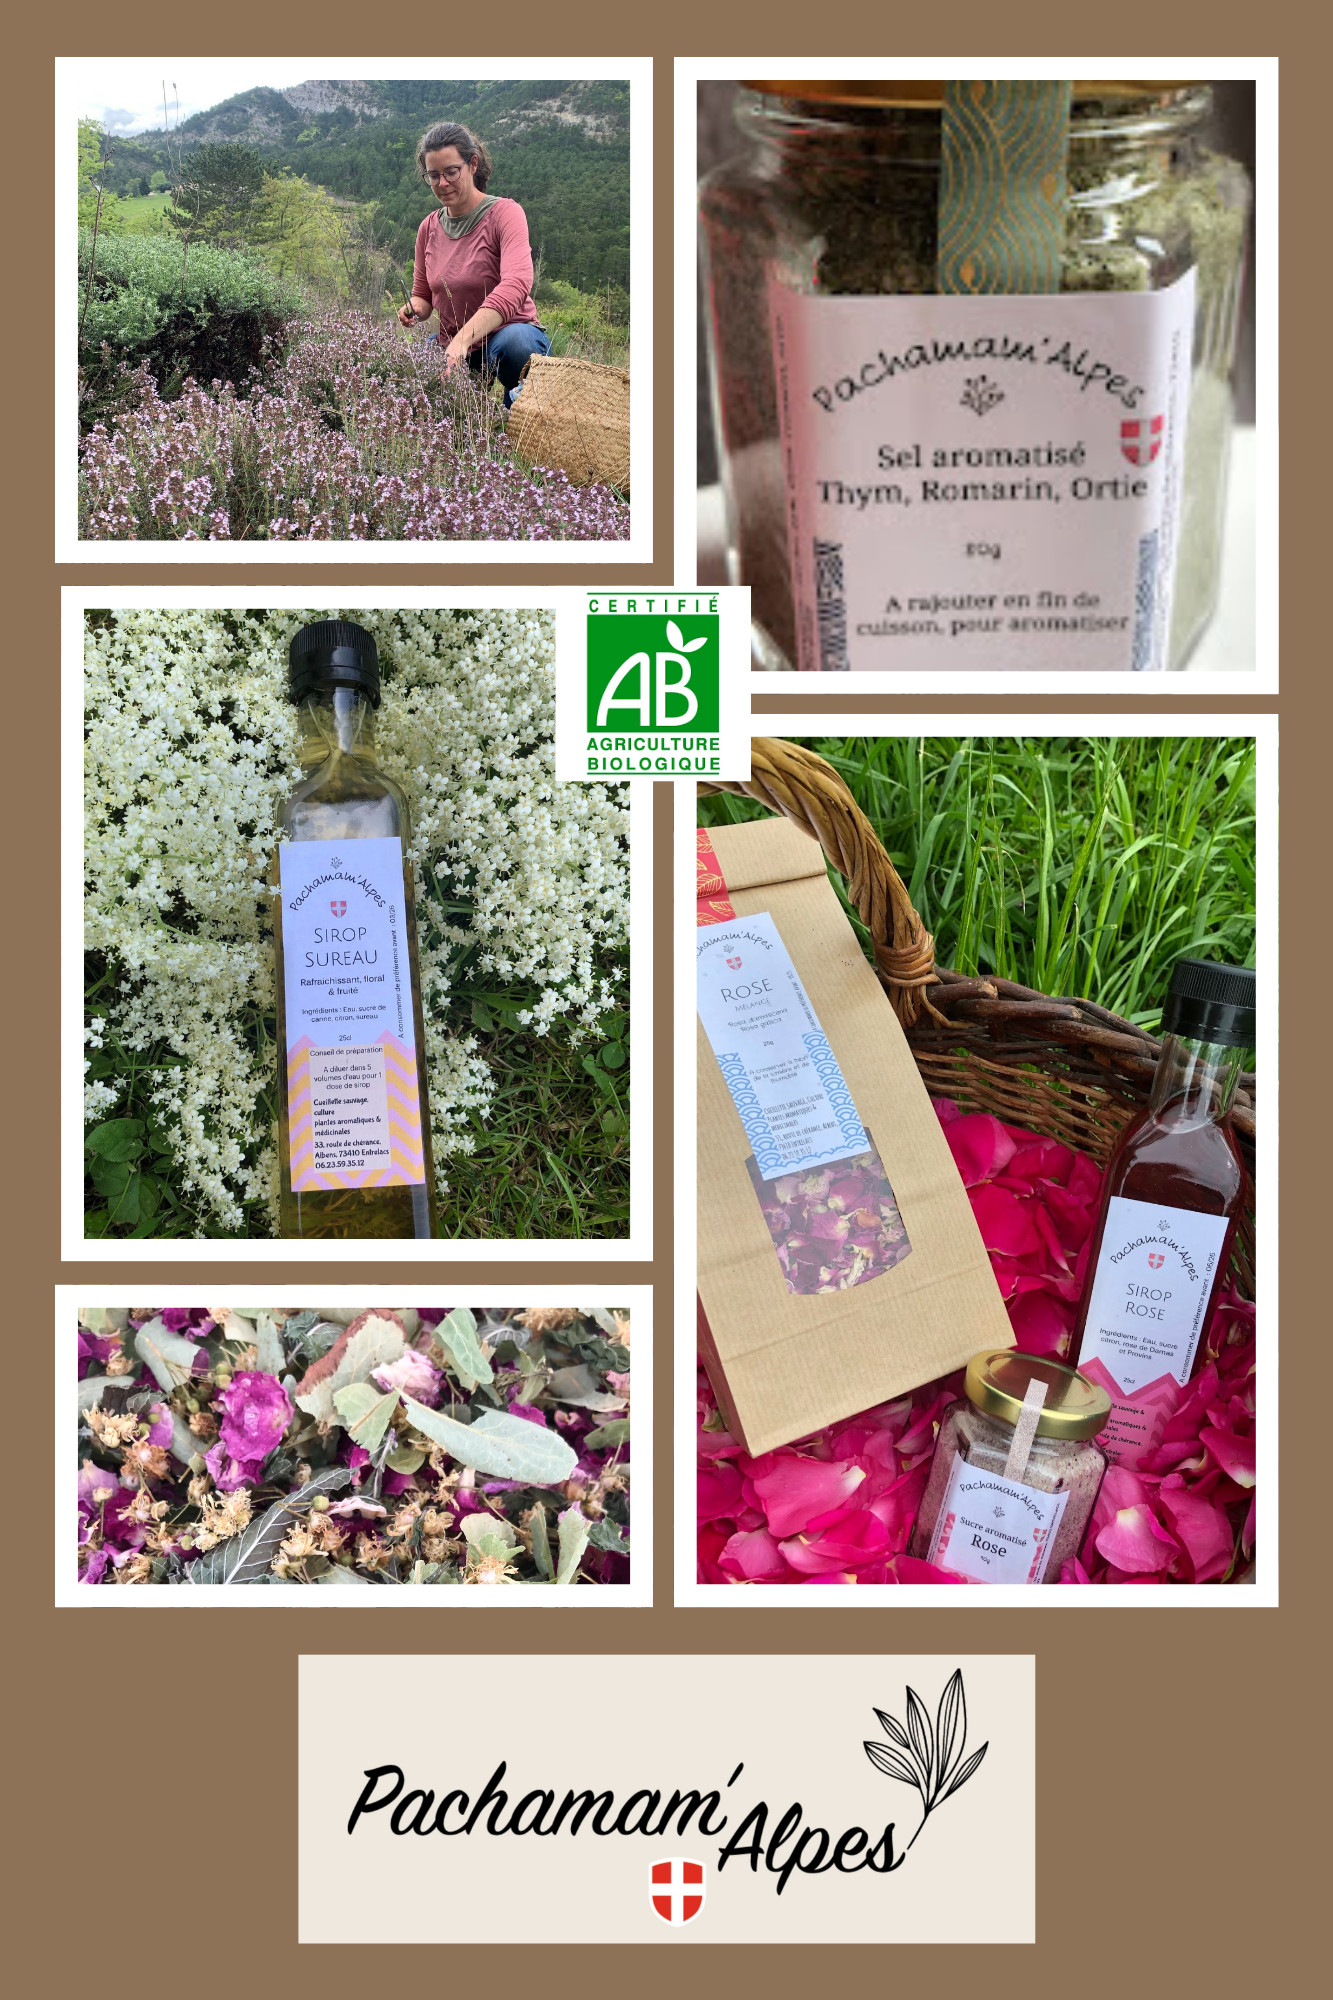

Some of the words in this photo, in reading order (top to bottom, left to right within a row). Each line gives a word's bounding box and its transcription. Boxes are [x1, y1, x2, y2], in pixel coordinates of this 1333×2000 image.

[812, 335, 1147, 414] Pachamam'Alpes
[878, 444, 921, 469] Sel
[932, 442, 1086, 468] aromatisé
[817, 479, 912, 510] Thym,
[921, 478, 1061, 504] Romarin,
[1071, 475, 1148, 499] Ortie
[886, 596, 901, 613] A
[908, 593, 997, 613] rajouter
[1003, 594, 1030, 609] en
[1036, 590, 1067, 608] fin
[1073, 591, 1100, 608] de
[856, 619, 944, 636] cuisson,
[951, 616, 1002, 636] pour
[1008, 614, 1129, 633] aromatiser
[290, 872, 386, 911] Pachamam'Alpes
[314, 927, 366, 943] SIROP
[305, 950, 377, 968] SUREAU
[364, 974, 385, 983] floral
[337, 987, 358, 995] fruité
[721, 979, 773, 1002] ROSE
[302, 1007, 338, 1016] Ingrédients
[735, 998, 770, 1011] MÉLANGE
[346, 1047, 383, 1055] préparation
[314, 1119, 336, 1128] plantes
[337, 1117, 374, 1125] aromatiques
[315, 1128, 350, 1136] médicinales
[339, 1149, 360, 1157] 73410
[361, 1148, 389, 1156] Entrelacs
[315, 1160, 365, 1169] 06.23.59.35.12
[1110, 1236, 1199, 1281] Pachamam'Alpes
[1126, 1283, 1172, 1302] SIROP
[1125, 1301, 1165, 1320] ROSE
[1181, 1341, 1194, 1378] consommer
[1190, 1332, 1196, 1341] de
[1193, 1295, 1205, 1331] préférence
[1201, 1278, 1209, 1296] avant
[1205, 1252, 1216, 1272] 06/26
[1100, 1328, 1138, 1341] Ingrédients
[1159, 1341, 1178, 1350] sucre
[1101, 1337, 1121, 1346] citron,
[1123, 1341, 1138, 1349] rose
[1150, 1347, 1174, 1357] Damas
[1128, 1349, 1152, 1360] Provins
[960, 1480, 1044, 1520] Pachamam'Alpes
[960, 1516, 984, 1531] Sucre
[985, 1527, 1027, 1547] aromatisé
[971, 1534, 1007, 1557] Rose
